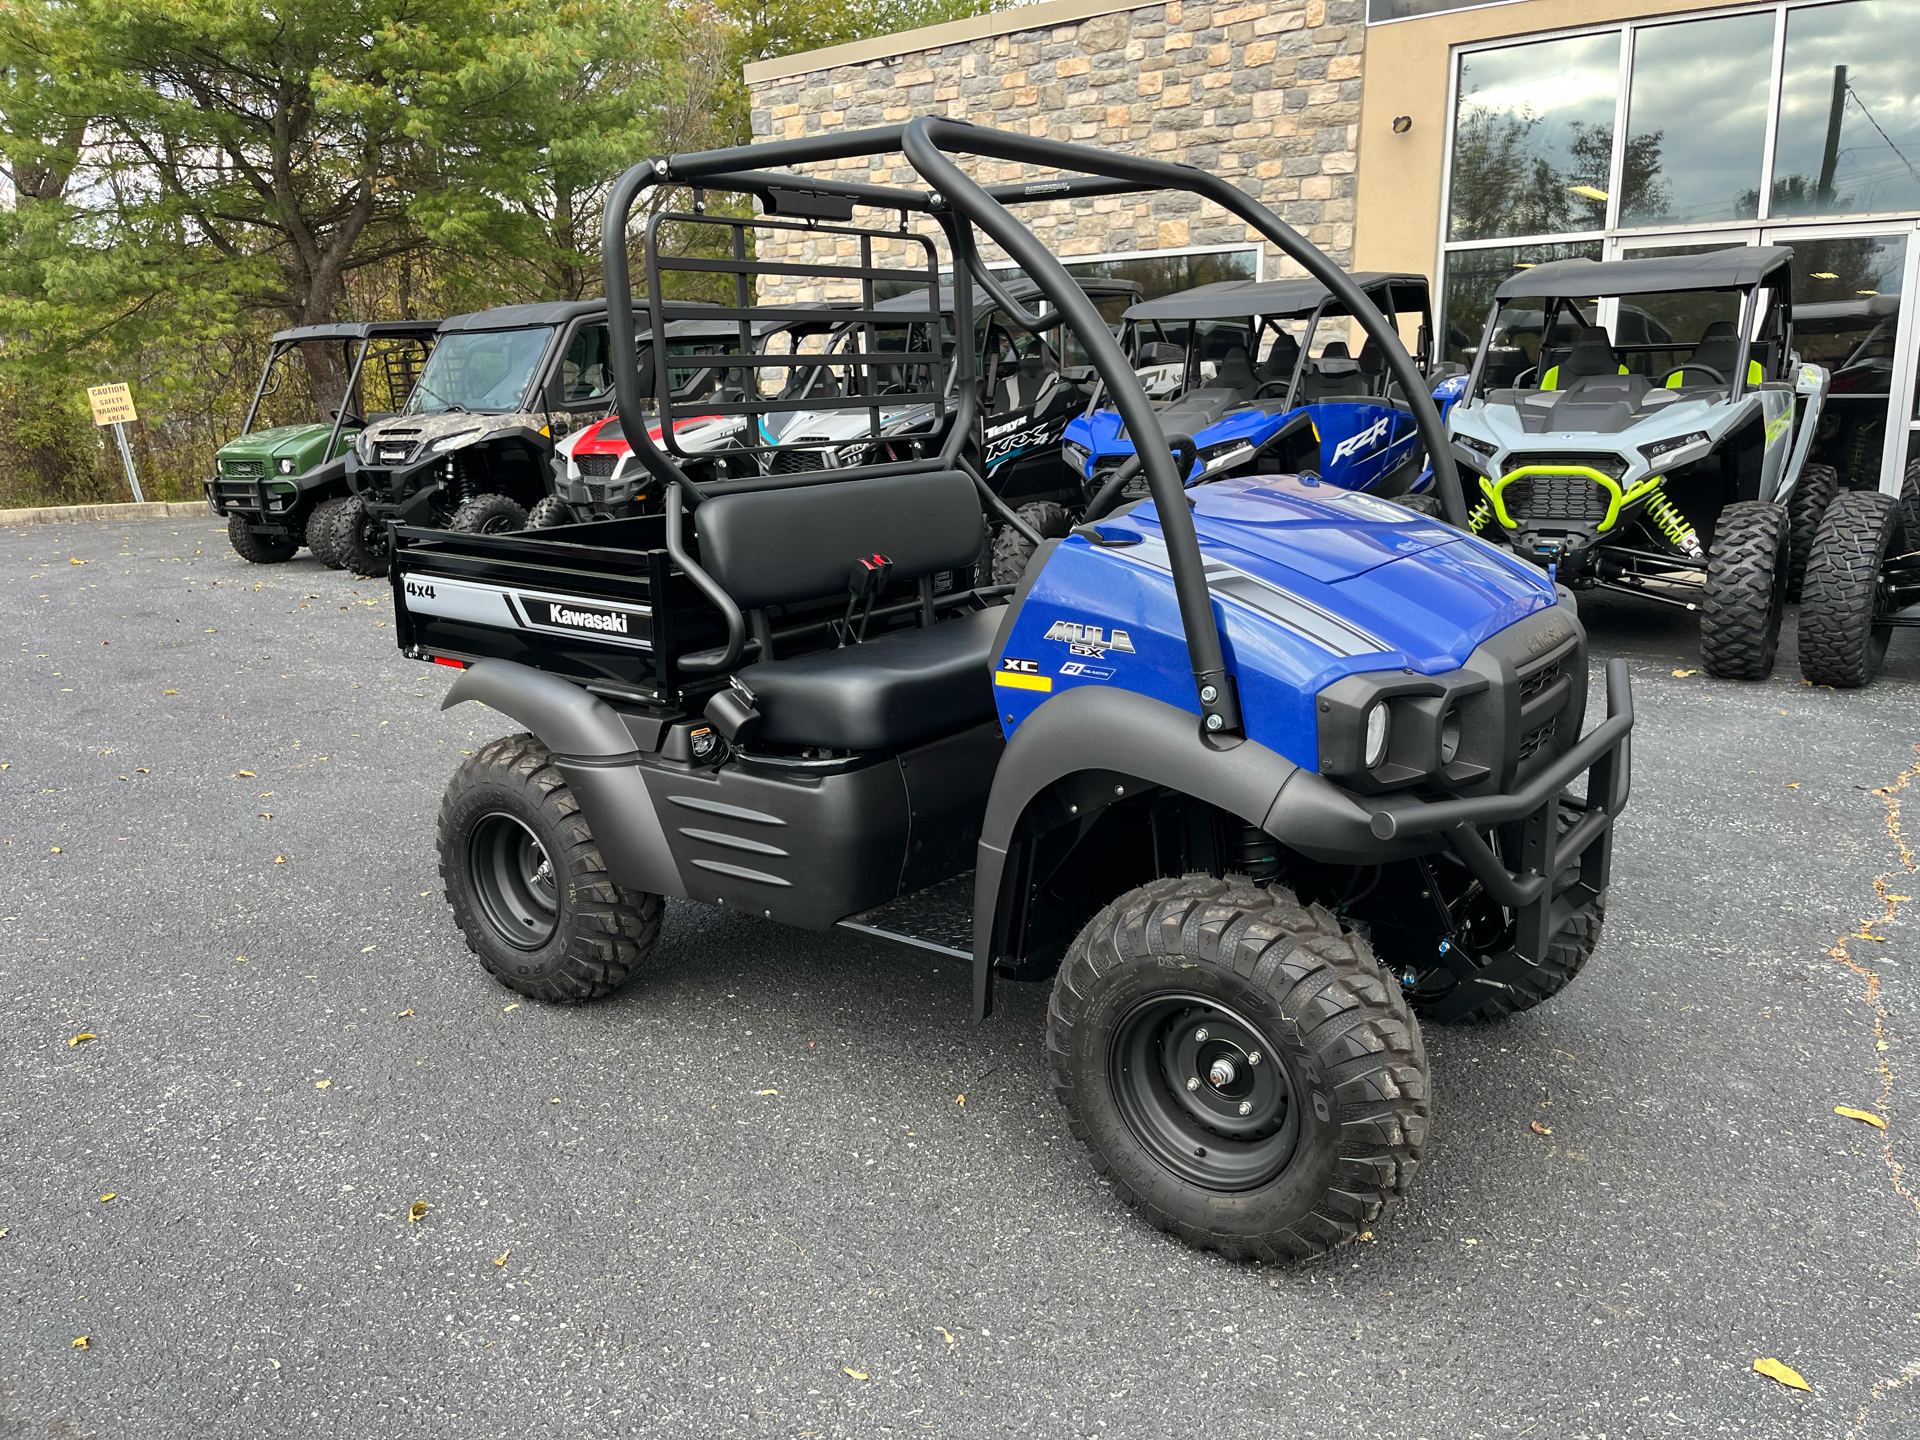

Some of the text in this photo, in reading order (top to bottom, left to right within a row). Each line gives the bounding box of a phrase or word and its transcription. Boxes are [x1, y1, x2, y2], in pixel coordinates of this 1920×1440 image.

[92, 385, 126, 396] CAUTION
[100, 397, 123, 407] SAFETY
[99, 405, 130, 415] TRAINING
[108, 414, 126, 423] AREA
[1330, 417, 1389, 467] RZR
[406, 582, 436, 599] 4x4
[550, 604, 628, 633] Kawasaki
[1043, 620, 1136, 654] MULE
[1069, 643, 1106, 660] SX
[1003, 658, 1039, 673] XC
[1062, 664, 1081, 674] FI
